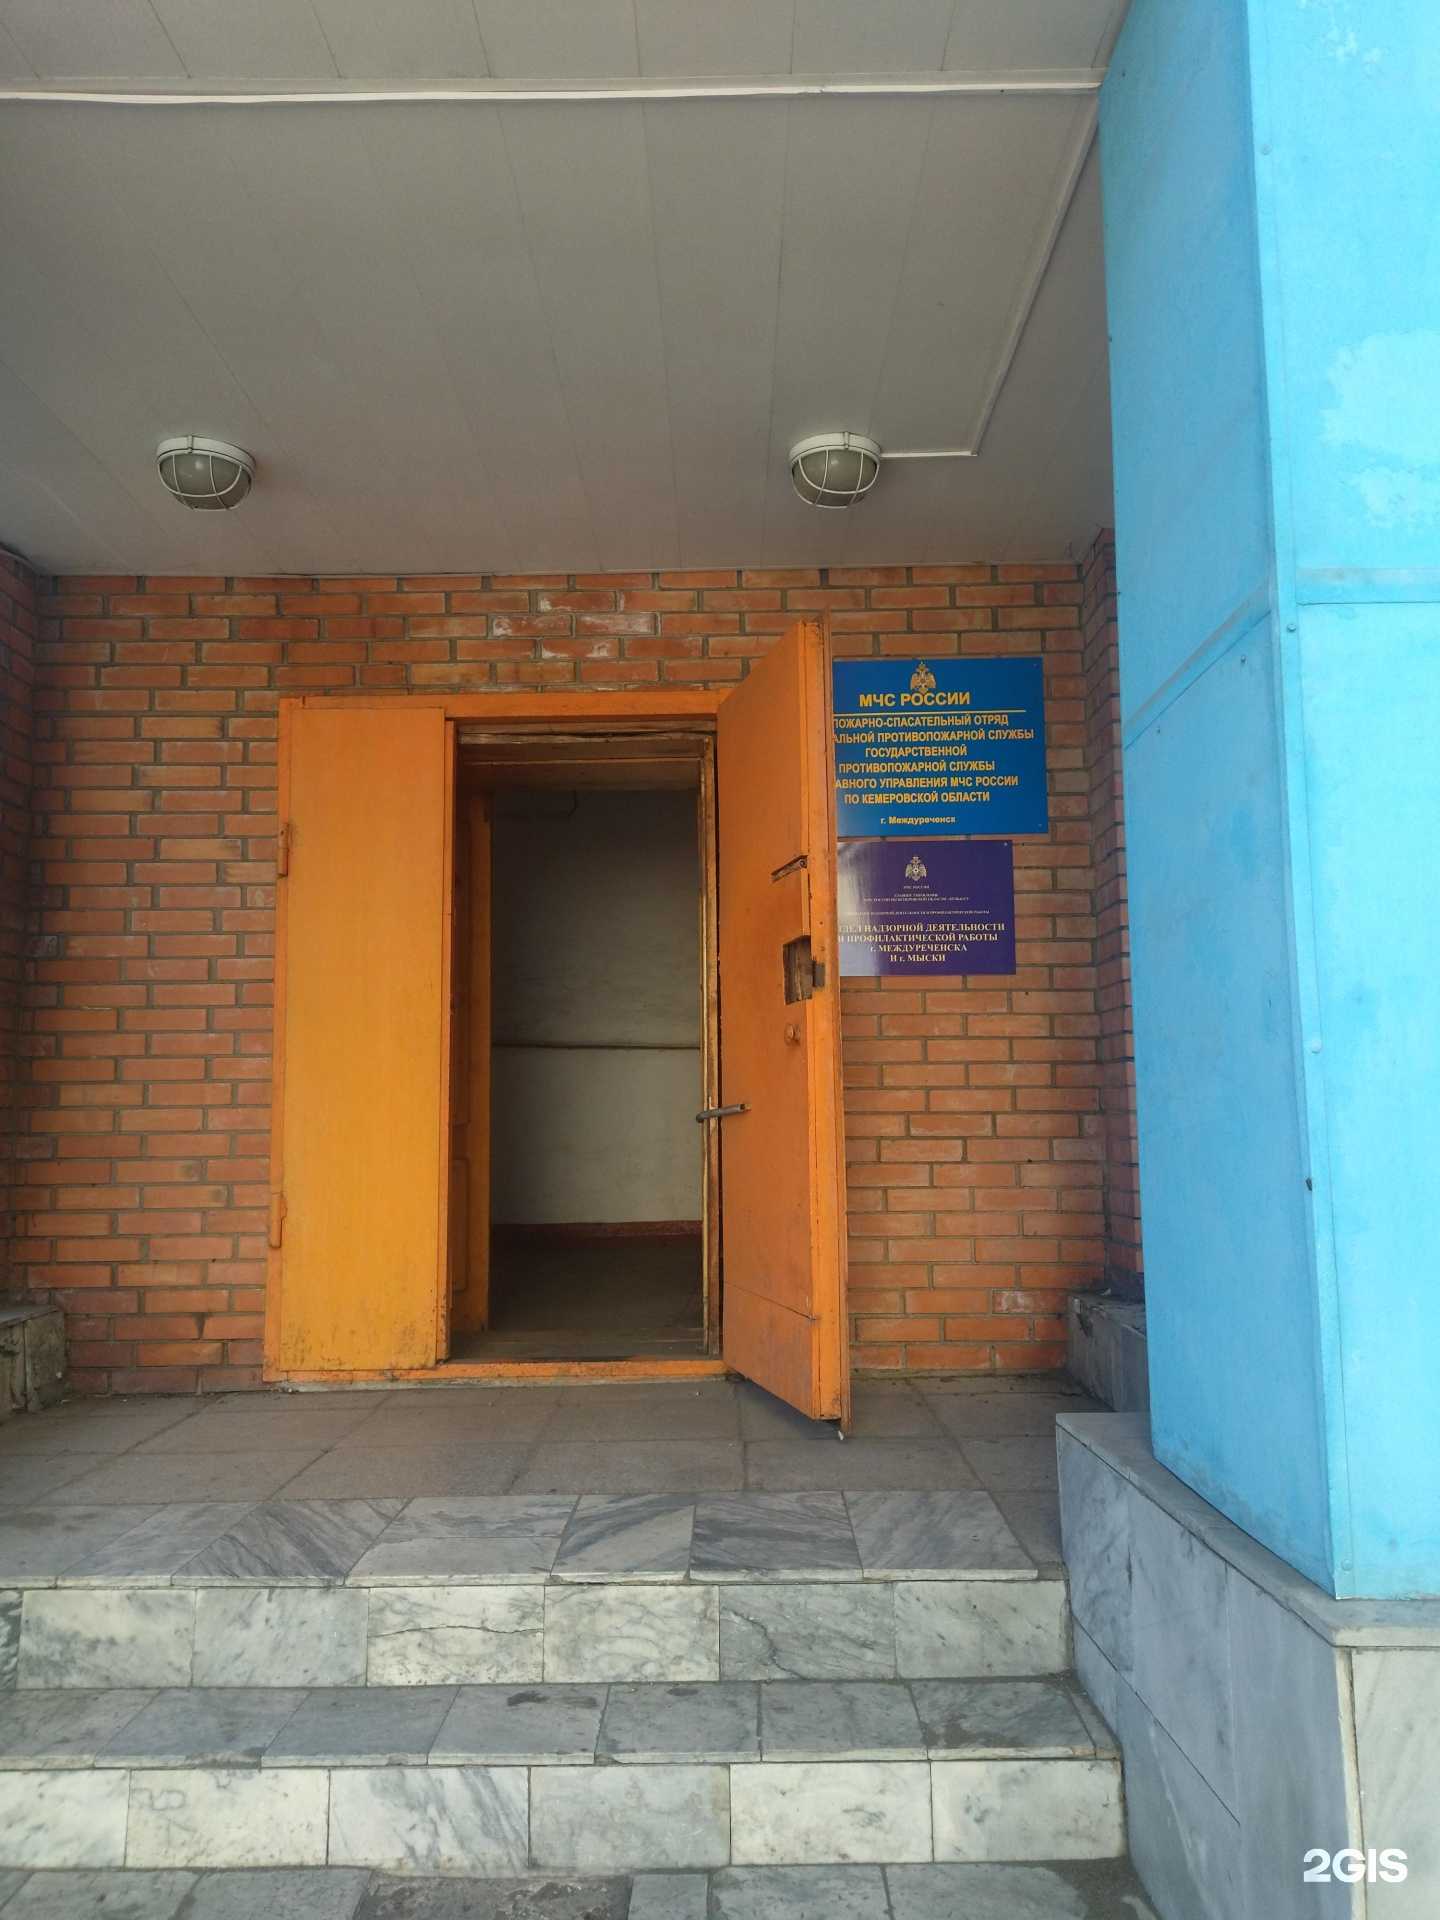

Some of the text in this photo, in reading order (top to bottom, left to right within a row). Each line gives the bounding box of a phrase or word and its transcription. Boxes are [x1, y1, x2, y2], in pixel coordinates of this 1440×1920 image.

[859, 692, 971, 707] МЧС РОССИИ
[974, 714, 1009, 727] ОТРЯД
[877, 728, 986, 743] ПРОТИВОПОЖАРНОЙ
[988, 729, 1034, 740] СЛУЖБЫ
[865, 744, 967, 759] ГОСУДАРСТВЕННОЙ
[839, 760, 995, 773] ПРОТИВОПОЖАРНОЙ СЛУЖБЫ
[880, 777, 948, 789] УПРАВЛЕНИЯ
[950, 776, 973, 787] МЧС
[976, 775, 1019, 787] РОССИИ
[844, 791, 990, 805] ПО КЕМЕРОВСКОЙ ОБЛАСТИ
[864, 922, 924, 932] НАДЗОРНОЙ
[925, 922, 1005, 932] ДЕЯТЕЛЬНОСТИ
[846, 933, 957, 943] ПРОФИЛАКТИЧЕСКОЙ
[958, 933, 998, 942] РАБОТЫ
[878, 943, 968, 953] МЕЖДУРЕЧЕНСКА
[890, 954, 898, 963] И
[908, 953, 946, 962] МЫСКИ
